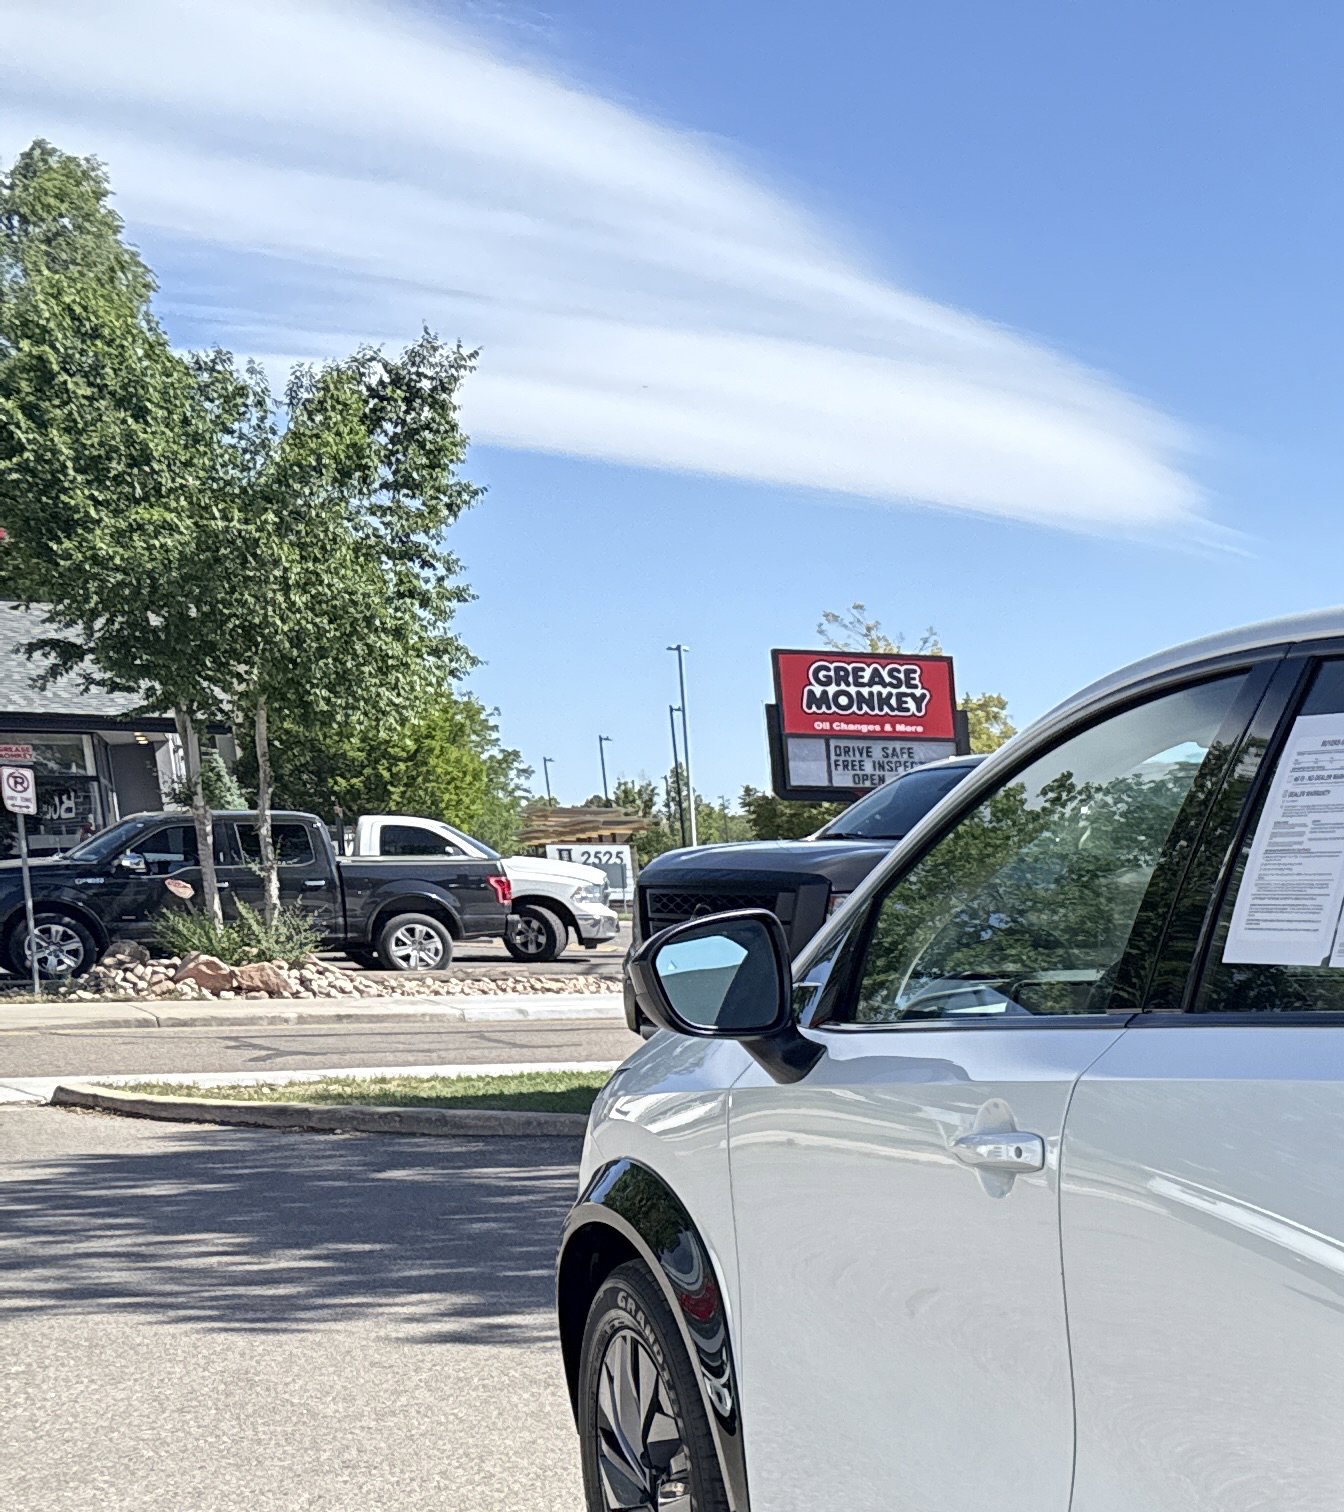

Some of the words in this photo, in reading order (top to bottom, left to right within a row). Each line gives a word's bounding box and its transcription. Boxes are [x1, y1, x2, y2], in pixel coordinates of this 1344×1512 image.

[811, 664, 919, 690] GREASE
[804, 688, 928, 715] MONKEY
[813, 721, 830, 731] Oil
[832, 721, 881, 733] Changes
[884, 723, 892, 732] &
[895, 723, 924, 733] More
[833, 744, 874, 758] DRIVE
[881, 746, 915, 759] SAFE
[833, 759, 866, 772] FREE
[852, 773, 886, 786] OPEN
[580, 850, 625, 866] 2525
